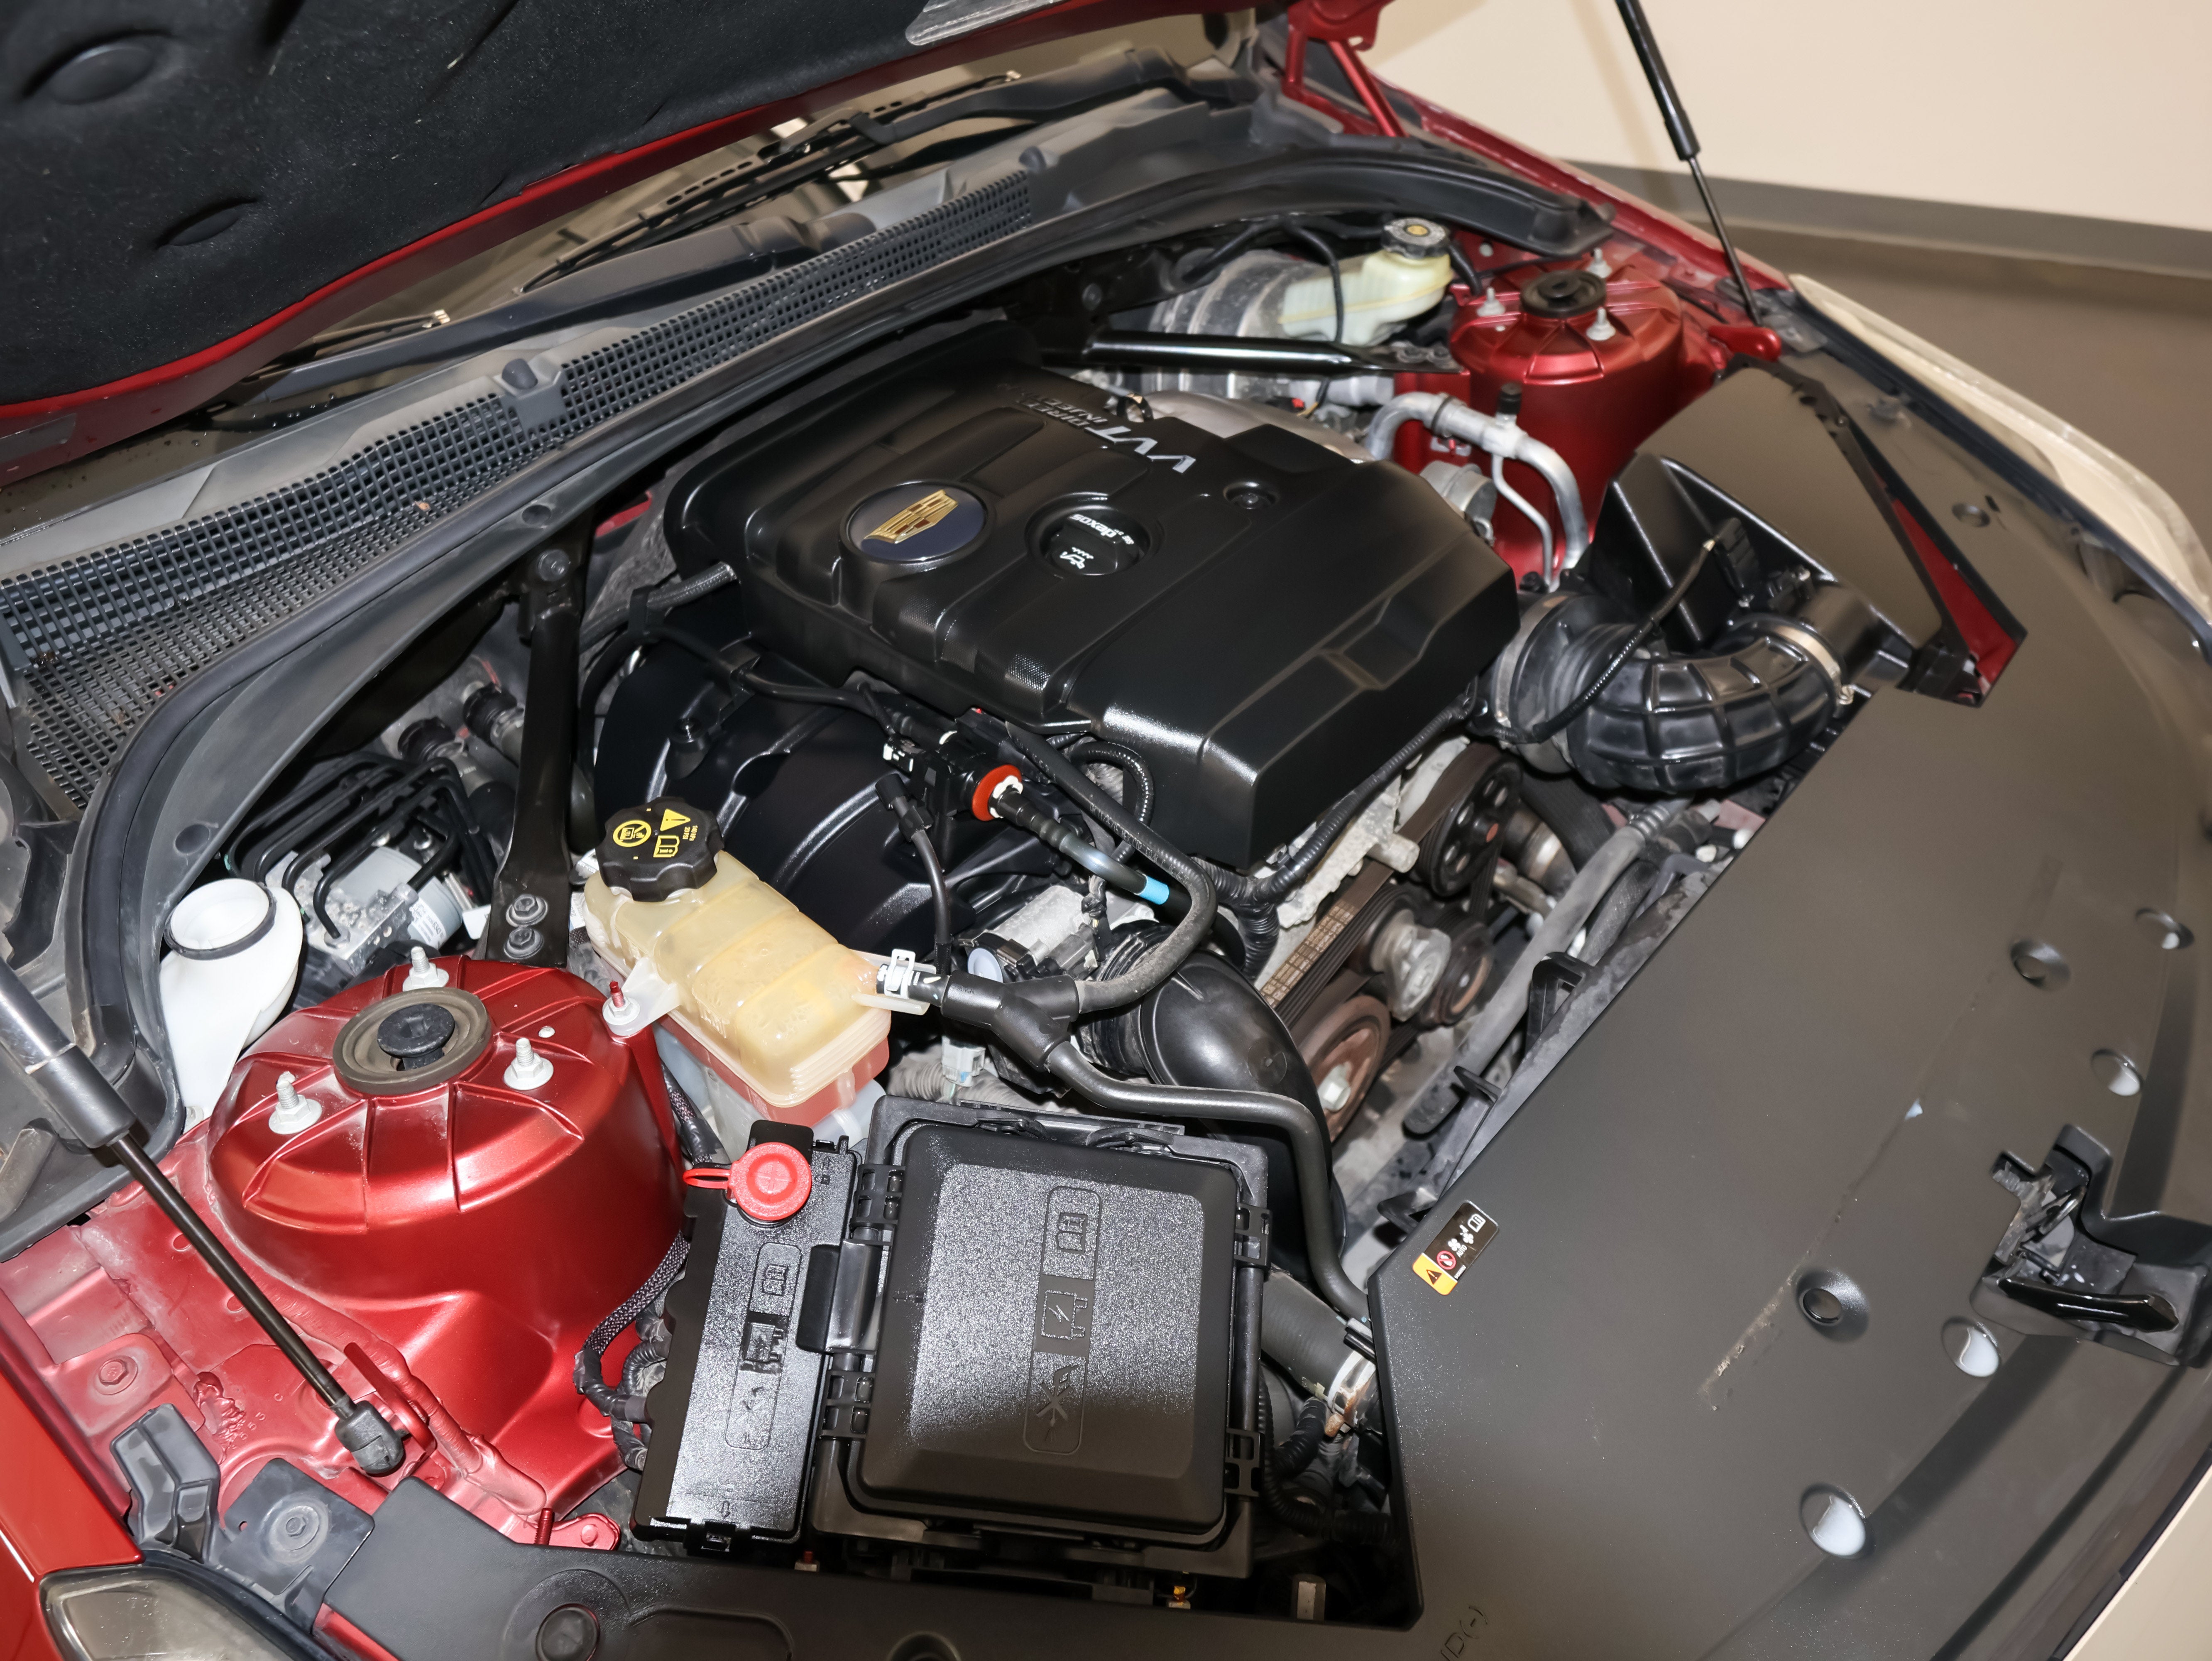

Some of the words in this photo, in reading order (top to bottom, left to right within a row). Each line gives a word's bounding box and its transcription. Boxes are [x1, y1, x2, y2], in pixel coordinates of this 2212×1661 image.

[1084, 426, 1196, 473] VVT
[1068, 514, 1117, 538] dexos
[1456, 1245, 1467, 1257] AUTO
